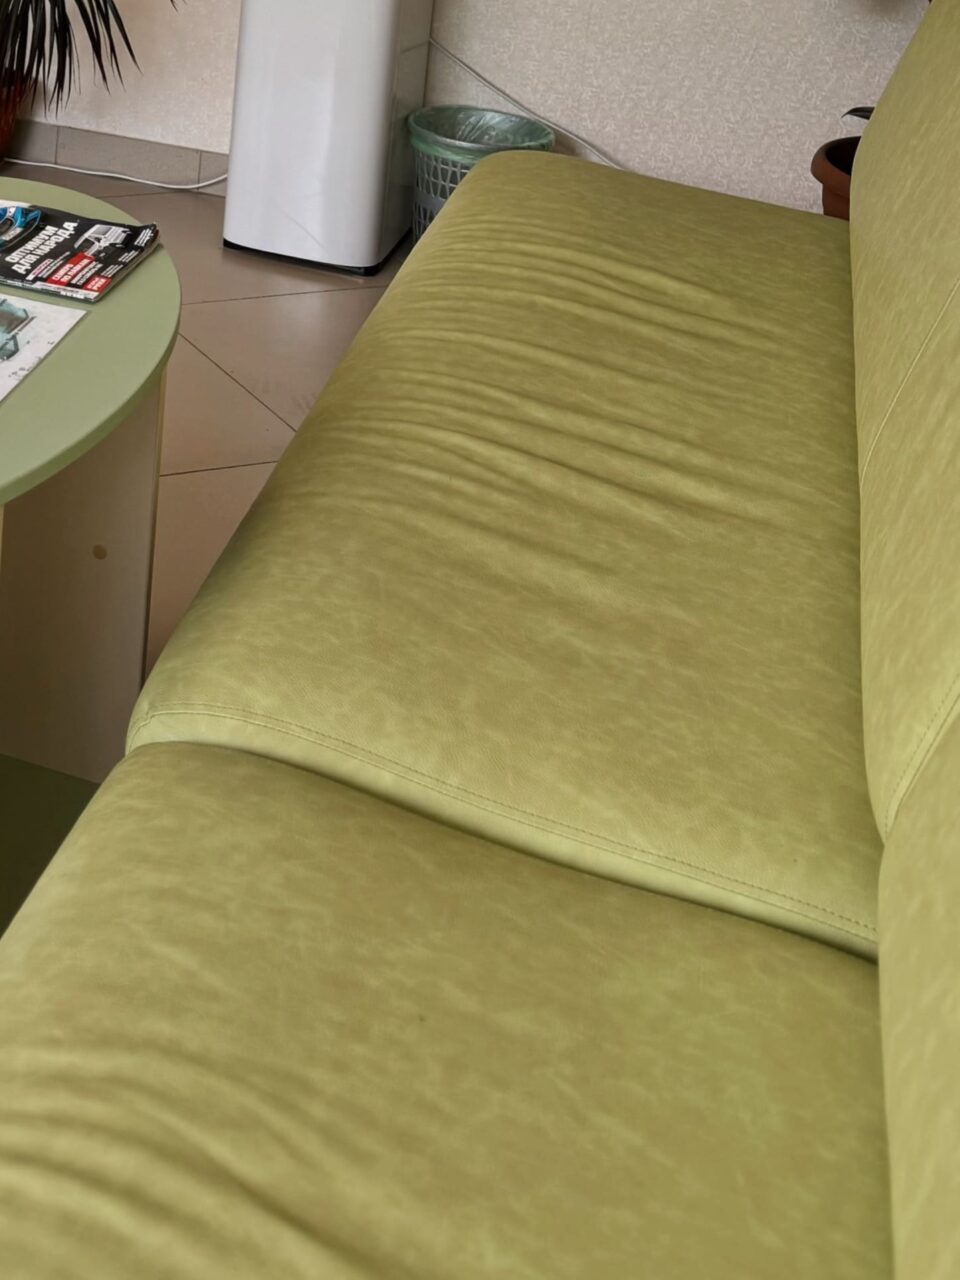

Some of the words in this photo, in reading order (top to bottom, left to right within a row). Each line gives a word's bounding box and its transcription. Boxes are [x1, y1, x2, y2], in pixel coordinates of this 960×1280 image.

[4, 224, 58, 263] ОПТИМУМ
[11, 250, 41, 275] ДЛЯ
[35, 220, 79, 257] НАРОДА
